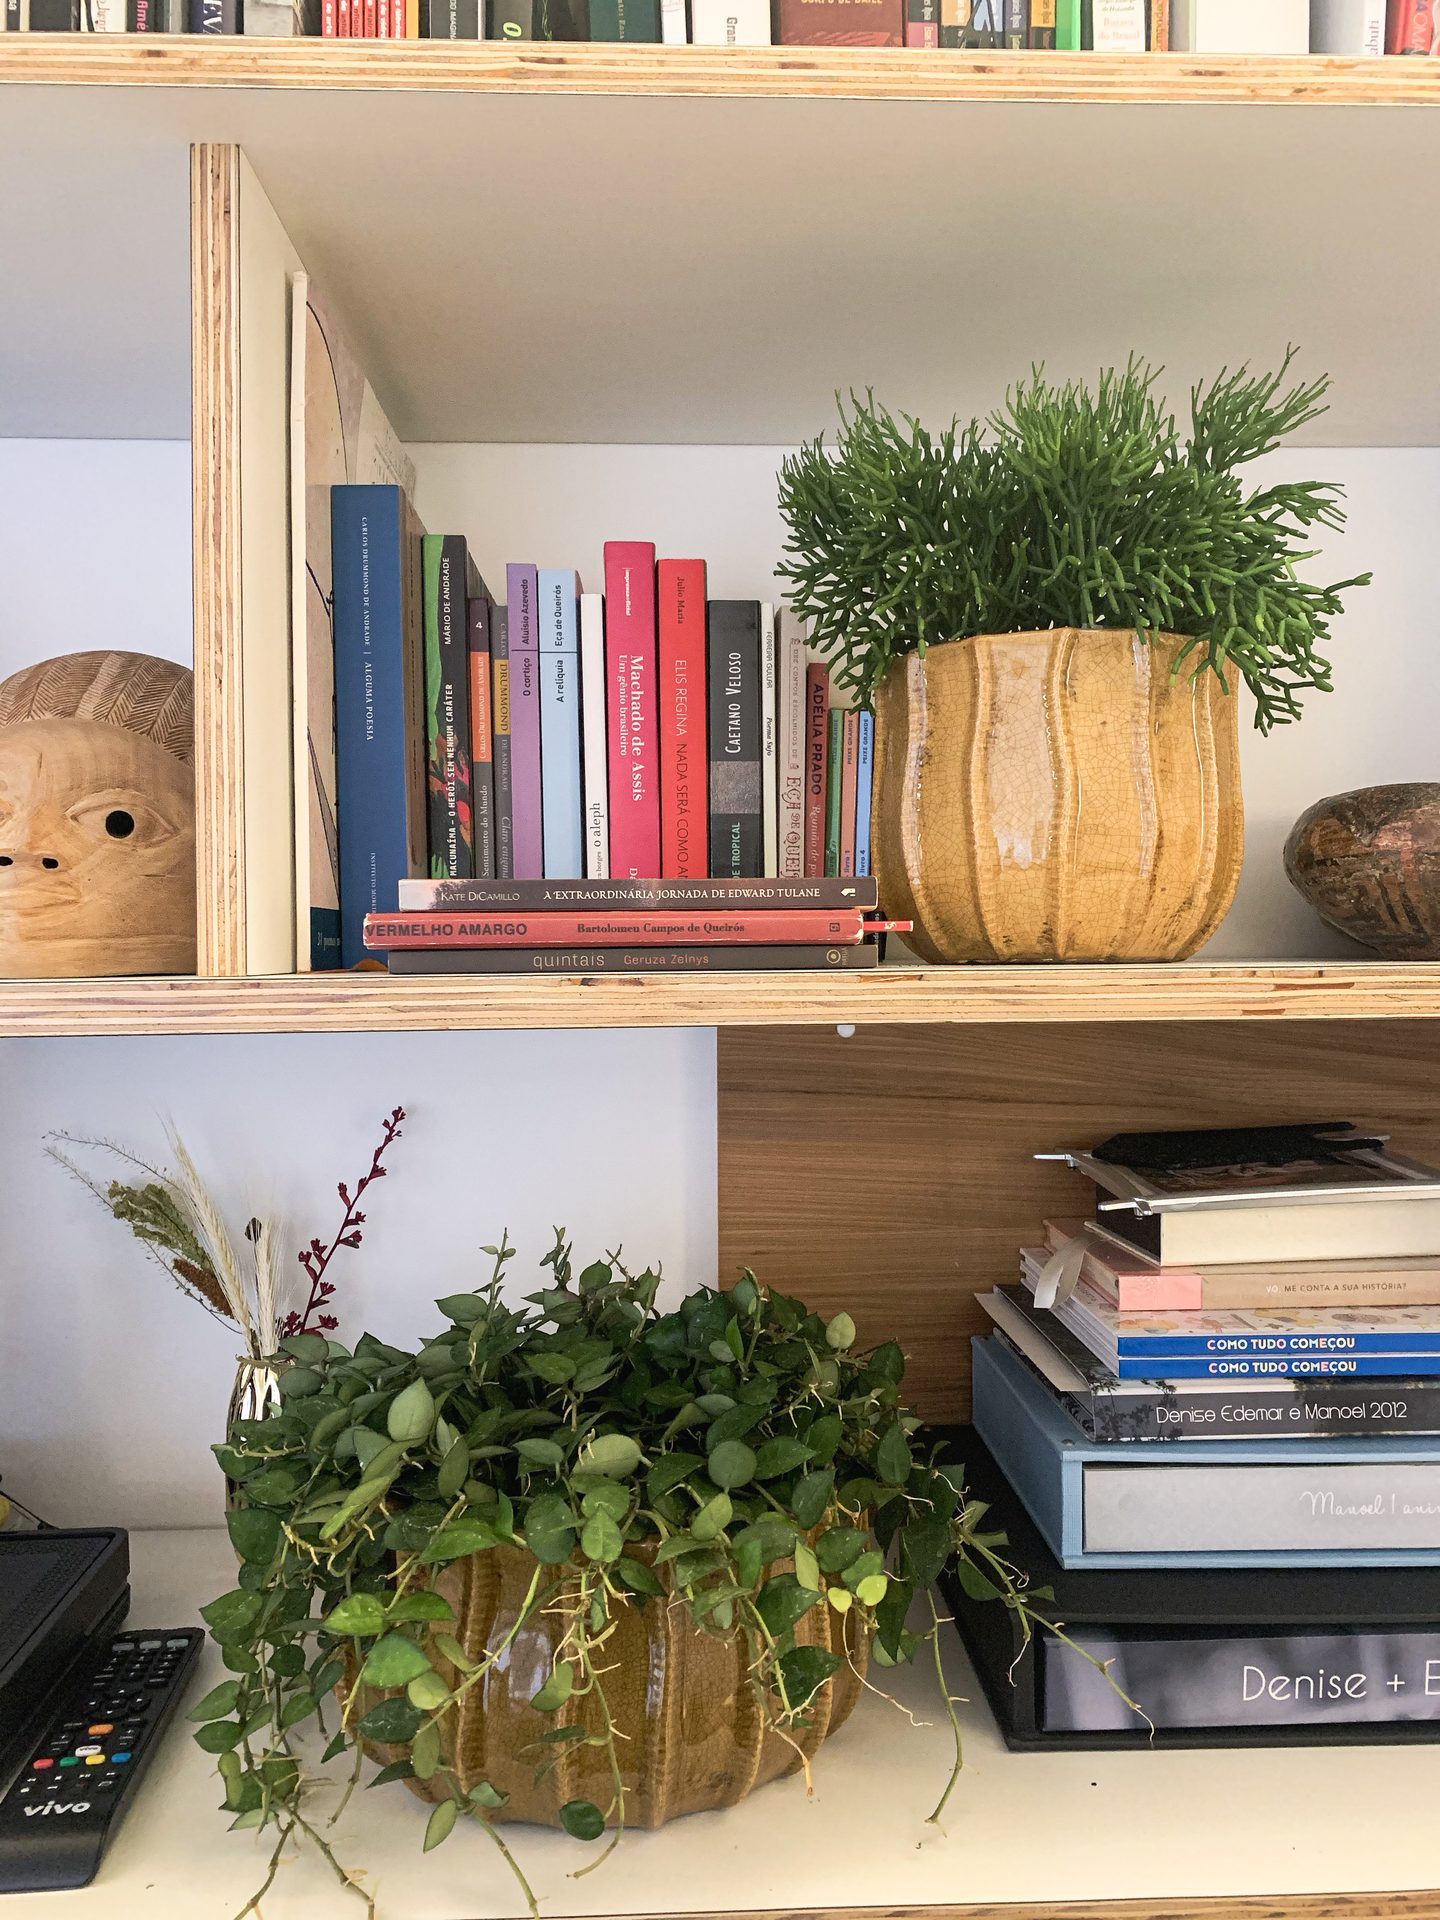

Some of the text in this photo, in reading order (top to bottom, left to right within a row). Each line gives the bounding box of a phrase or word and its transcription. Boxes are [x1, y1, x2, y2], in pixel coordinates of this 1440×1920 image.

[361, 516, 371, 647] CARLOS DRUMMOND DE ANDRADE
[520, 578, 529, 614] Azevedo
[442, 557, 452, 645] MÁRIO DE ANDRADE
[552, 585, 564, 647] Eça de Queirós
[677, 599, 685, 624] Maria
[475, 621, 483, 630] 4
[521, 657, 533, 697] O cortiço
[365, 661, 375, 741] ALGUMA POESIA
[443, 684, 455, 722] CARÁTER
[500, 663, 509, 731] DRUMMOND
[556, 695, 564, 703] A
[617, 654, 629, 757] Um gênio brasileiro
[675, 659, 688, 737] ELIS REGINA
[724, 652, 741, 754] CAETANO VELOSO
[446, 725, 455, 758] NENHUM
[629, 654, 646, 801] Machado de Assis
[765, 717, 774, 756] Poema Sujo
[811, 682, 826, 796] ADÉLIA PRADO
[447, 761, 455, 778] SEM
[501, 752, 509, 793] ANDRADE
[676, 743, 689, 782] NADA
[445, 781, 456, 808] HERÓI
[676, 784, 691, 815] SERÁ
[479, 785, 491, 877] Sentimento do Mundo
[589, 802, 605, 837] aleph
[809, 804, 821, 847] Reunião
[446, 827, 457, 876] MACUNAÍMA
[499, 816, 511, 878] Claro enigma
[593, 839, 602, 848] o
[676, 818, 689, 863] COMO
[731, 822, 740, 867] TROPICAL
[811, 848, 819, 861] de
[441, 890, 466, 901] KATE
[543, 887, 821, 901] A EXTRAORDINÁRIA JORNADA DE EDWARD TULANE
[366, 923, 528, 937] VERMELHO AMARGO
[643, 923, 685, 935] Campos
[687, 922, 700, 933] de
[703, 921, 745, 934] Queirós
[532, 952, 605, 968] quintais
[623, 954, 666, 966] Geruza
[1284, 1284, 1297, 1293] ME
[1300, 1284, 1331, 1293] CONTA
[1333, 1284, 1340, 1292] A
[1342, 1283, 1360, 1292] SUA
[1362, 1281, 1408, 1291] HISTÓRIA?
[1206, 1337, 1356, 1352] COMO TUDO COMEÇOU
[1208, 1360, 1357, 1375] COMO TUDO COMEÇOU
[1156, 1401, 1408, 1424] Denise Edemar e Manoel 2012
[1299, 1490, 1386, 1516] Manoel
[1242, 1665, 1368, 1701] Denise
[23, 1800, 91, 1817] vivo
